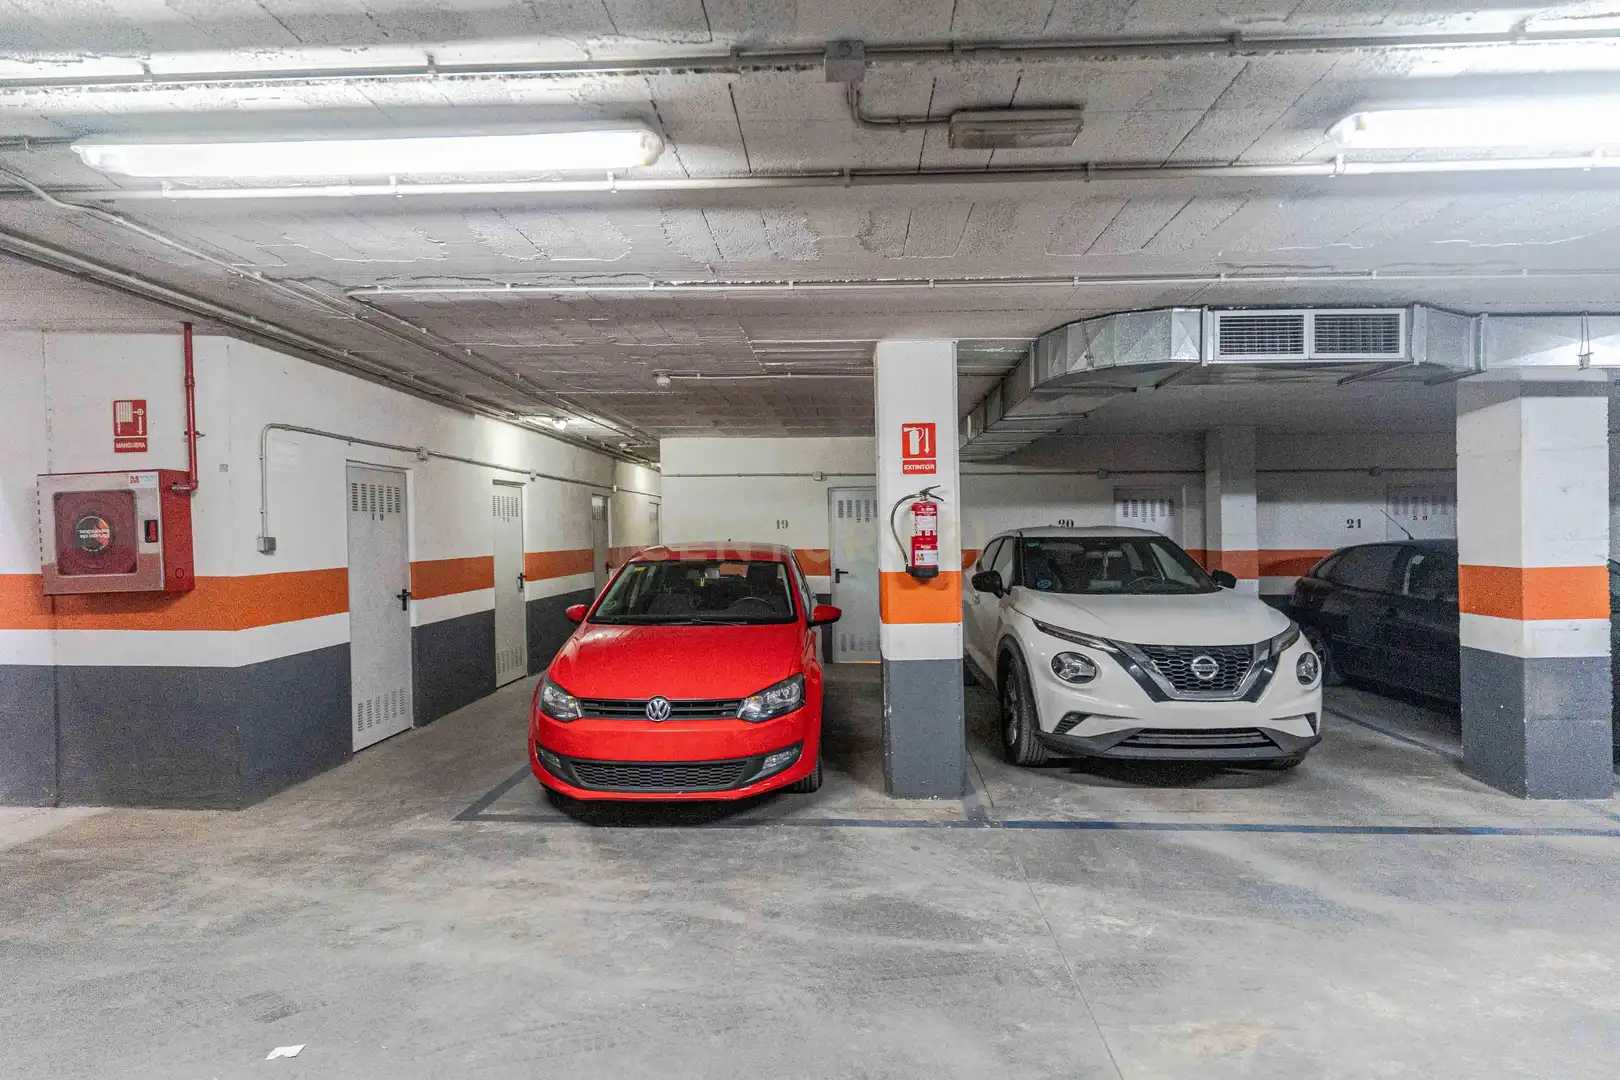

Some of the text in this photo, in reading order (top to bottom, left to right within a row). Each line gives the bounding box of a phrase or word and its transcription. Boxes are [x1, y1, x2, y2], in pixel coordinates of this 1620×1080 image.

[776, 520, 789, 529] 19
[1058, 519, 1074, 528] 20
[1346, 518, 1362, 529] 21
